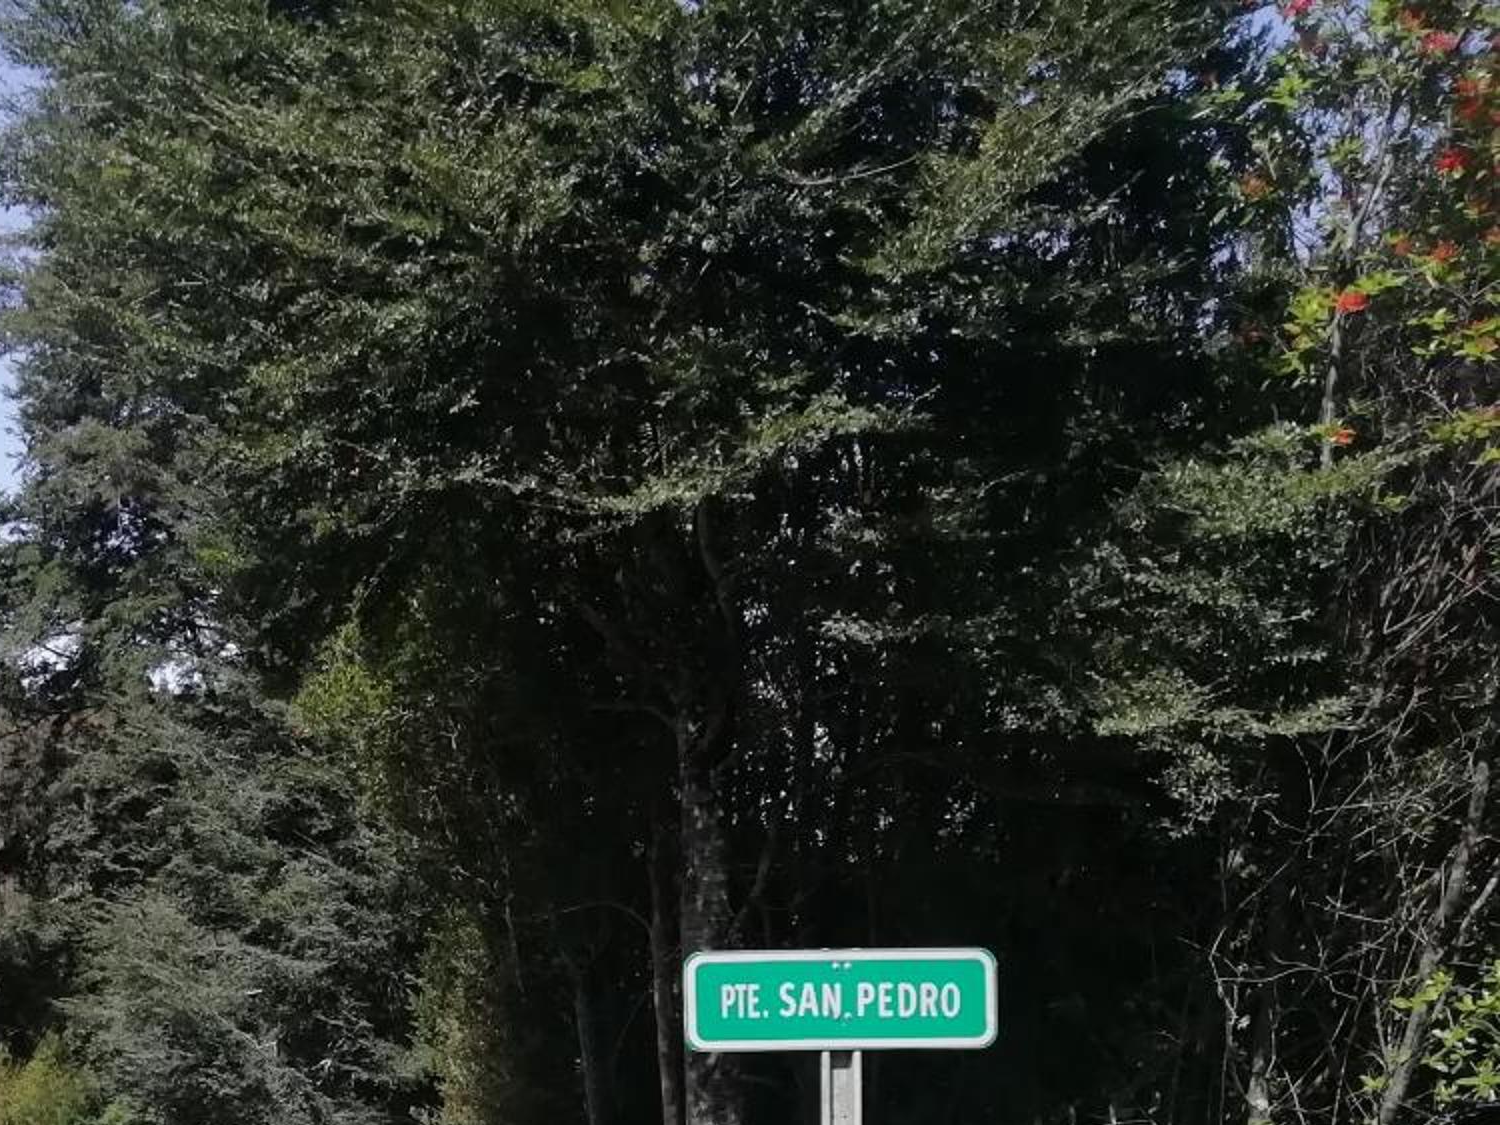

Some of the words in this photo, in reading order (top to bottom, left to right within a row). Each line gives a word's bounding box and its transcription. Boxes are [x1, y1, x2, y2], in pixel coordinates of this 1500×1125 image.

[721, 984, 769, 1018] PTE.
[779, 982, 841, 1018] SAN
[857, 982, 961, 1018] PEDRO
